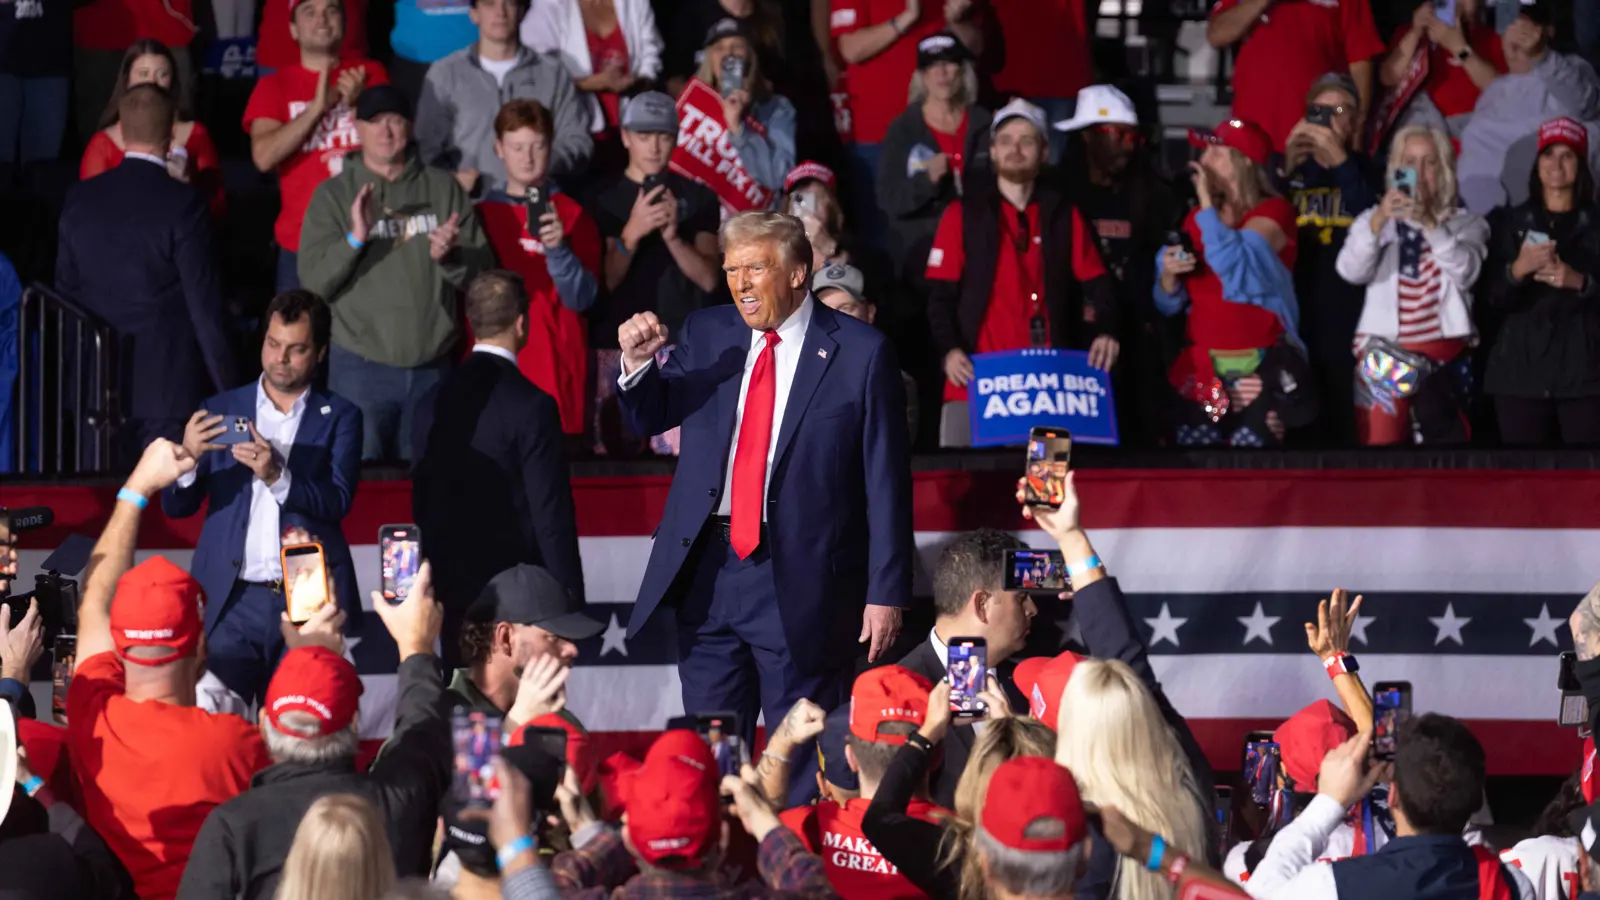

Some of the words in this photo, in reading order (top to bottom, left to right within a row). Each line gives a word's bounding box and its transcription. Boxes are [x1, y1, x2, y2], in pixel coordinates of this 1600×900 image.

[681, 103, 740, 160] TRU
[977, 373, 1059, 395] DREAM
[1063, 373, 1106, 396] BIG,
[983, 391, 1099, 419] AGAIN!
[881, 707, 919, 718] TRUMP
